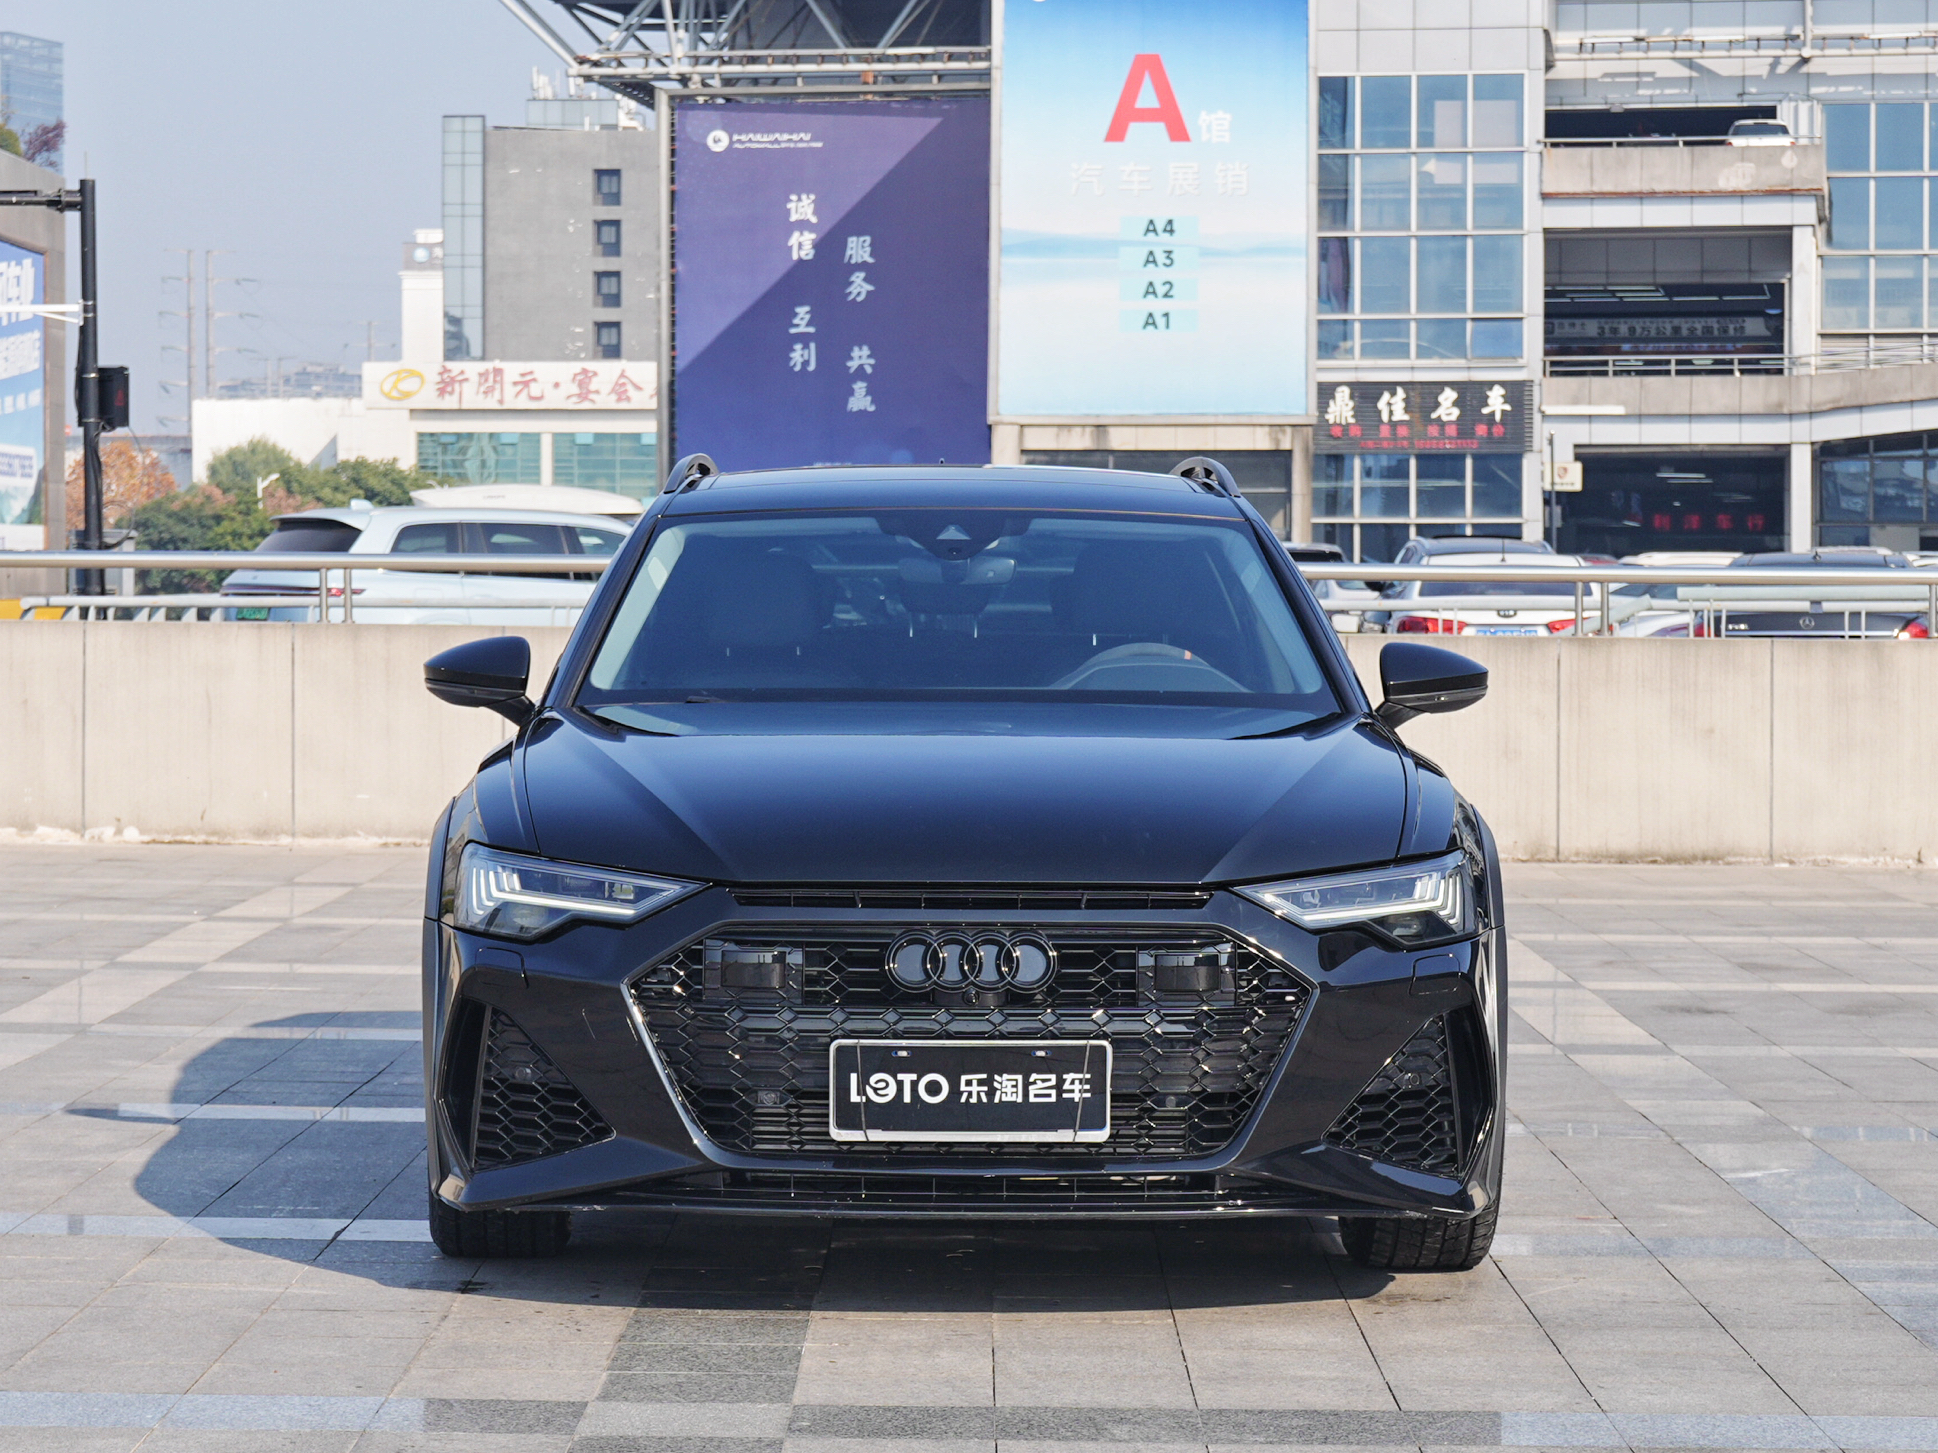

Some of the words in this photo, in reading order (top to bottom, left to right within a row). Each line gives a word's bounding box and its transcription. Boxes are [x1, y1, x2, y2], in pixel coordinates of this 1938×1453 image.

[1070, 161, 1250, 197] 汽车展销
[786, 193, 819, 261] 诚信
[1143, 219, 1176, 237] A4
[844, 235, 876, 303] 服务
[1143, 250, 1174, 268] A3
[1143, 281, 1174, 299] A2
[788, 305, 818, 372] 互利
[1142, 311, 1170, 330] A1
[435, 365, 657, 409] 新開元·宴会
[846, 344, 877, 413] 共赢
[1324, 384, 1513, 426] 鼎佳名车
[850, 1072, 950, 1104] LOTO
[959, 1073, 1092, 1104] 乐淘名车
